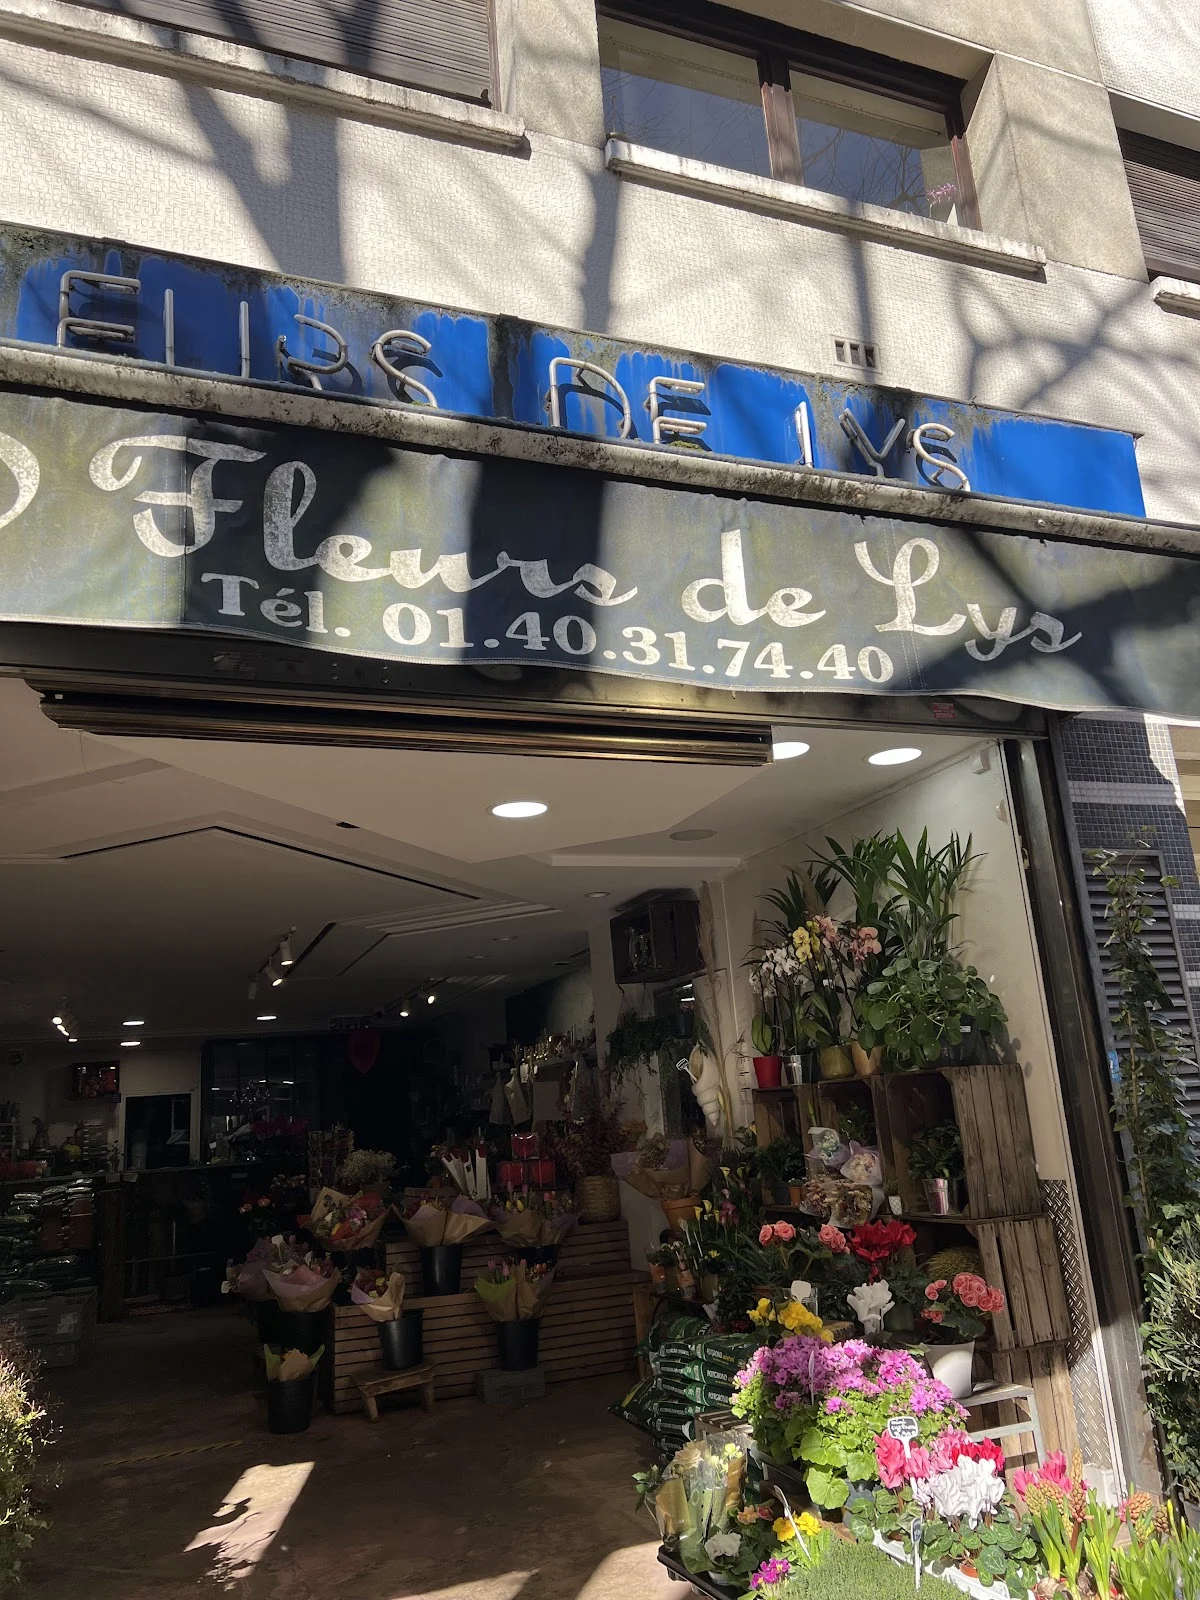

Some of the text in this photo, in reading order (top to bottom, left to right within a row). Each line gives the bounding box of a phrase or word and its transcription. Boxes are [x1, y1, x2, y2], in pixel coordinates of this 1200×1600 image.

[89, 434, 638, 605] Fleurs
[682, 530, 826, 627] de
[854, 537, 1082, 662] Lys
[200, 573, 894, 684] Tél. 01.40.31.74.40
